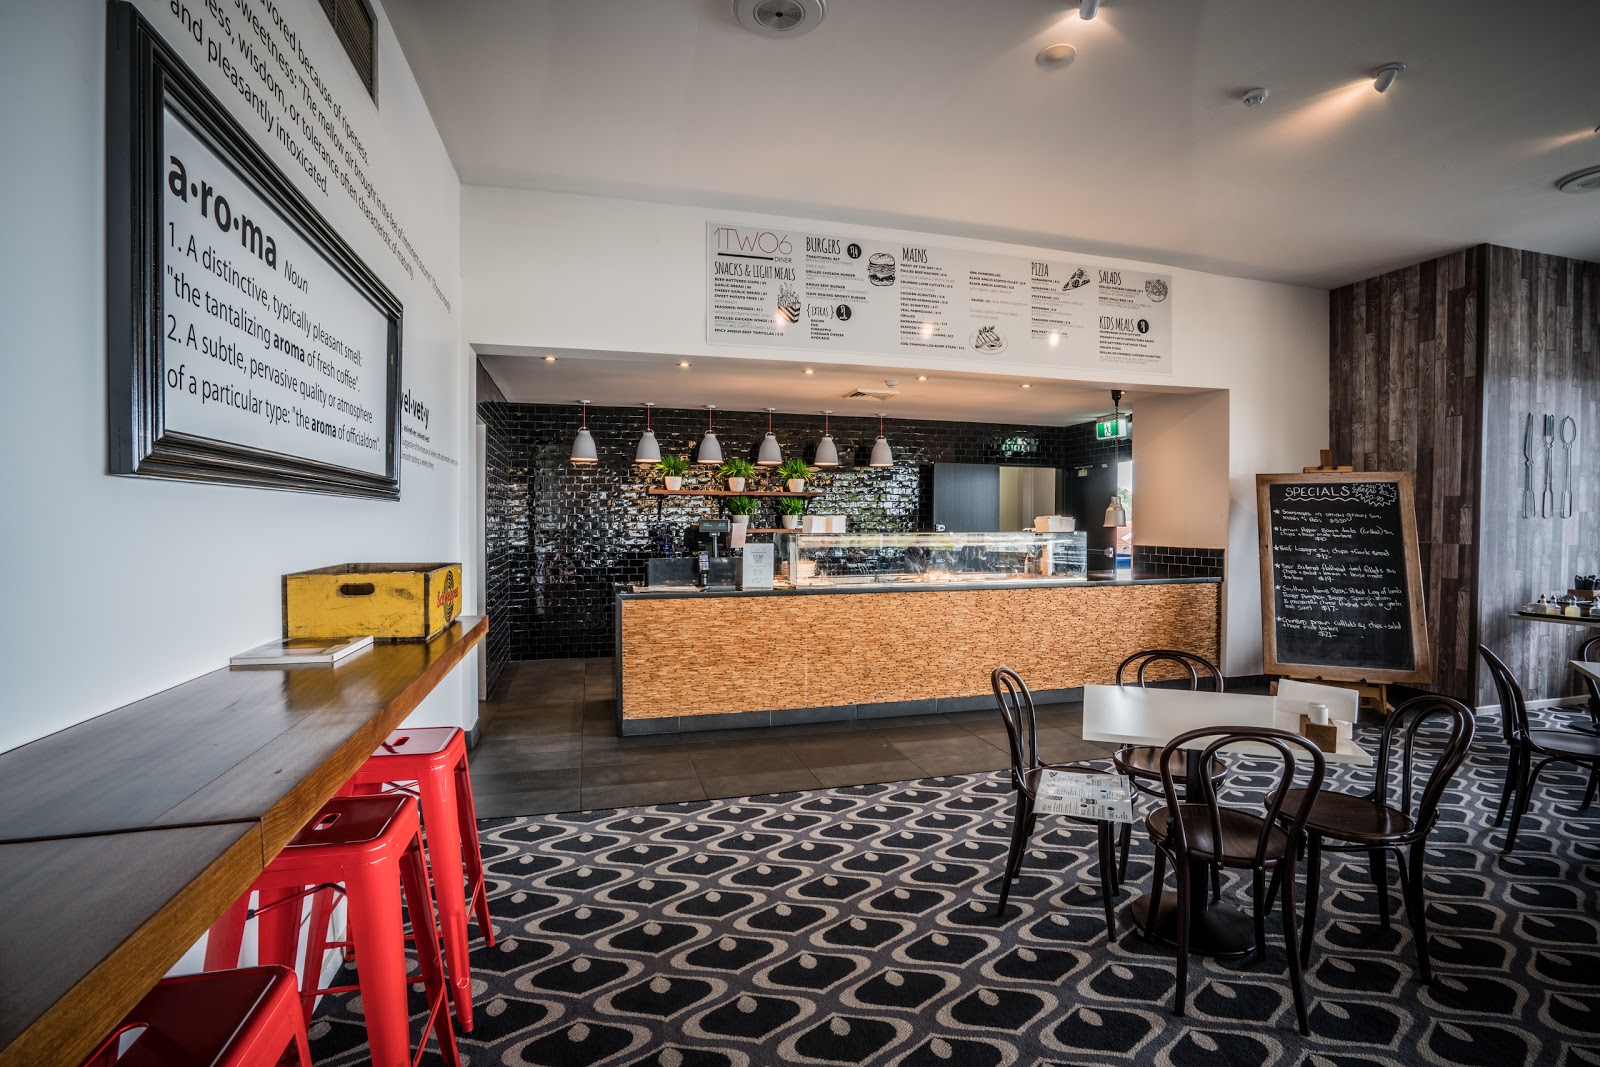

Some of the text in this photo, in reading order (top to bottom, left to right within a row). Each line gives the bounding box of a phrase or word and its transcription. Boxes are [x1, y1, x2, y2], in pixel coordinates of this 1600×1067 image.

[170, 0, 328, 197] and pleasantly intoxicated.
[298, 39, 332, 108] because
[333, 103, 341, 122] of
[342, 115, 369, 167] ripeness.
[237, 33, 287, 113] wisdom,
[289, 104, 300, 125] or
[302, 117, 339, 179] tolerance
[340, 171, 358, 203] often
[358, 195, 392, 250] characteristic
[298, 75, 317, 117] "The
[318, 110, 344, 155] mellow
[345, 151, 353, 169] air
[354, 159, 376, 203] brought
[376, 193, 382, 211] in
[714, 227, 793, 255] 1TWO6
[806, 236, 841, 255] BURGERS
[902, 246, 928, 264] MAINS
[714, 261, 743, 277] SNACKS
[744, 264, 752, 277] &
[752, 265, 773, 279] LIGHT
[774, 267, 796, 281] MEALS
[774, 256, 793, 264] DINER
[1031, 261, 1048, 277] PIZZA
[284, 259, 309, 294] Noun
[1098, 269, 1121, 285] SALADS
[168, 221, 363, 367] 1. A distinctive, typically pleasant smell:
[167, 265, 200, 308] "the
[205, 293, 271, 350] tantalizing
[273, 333, 305, 363] aroma
[306, 350, 316, 368] of
[316, 352, 336, 379] fresh
[1099, 315, 1115, 331] KIDS
[1115, 317, 1134, 332] MEALS
[167, 314, 373, 424] 2. A subtle, pervasive quality or atmosphere
[167, 364, 185, 390] of
[188, 375, 198, 395] a
[202, 380, 263, 415] particular
[265, 399, 291, 426] type:
[292, 406, 310, 431] "the
[311, 416, 337, 438] aroma
[338, 424, 346, 440] of
[1284, 485, 1350, 497] SPECIALS
